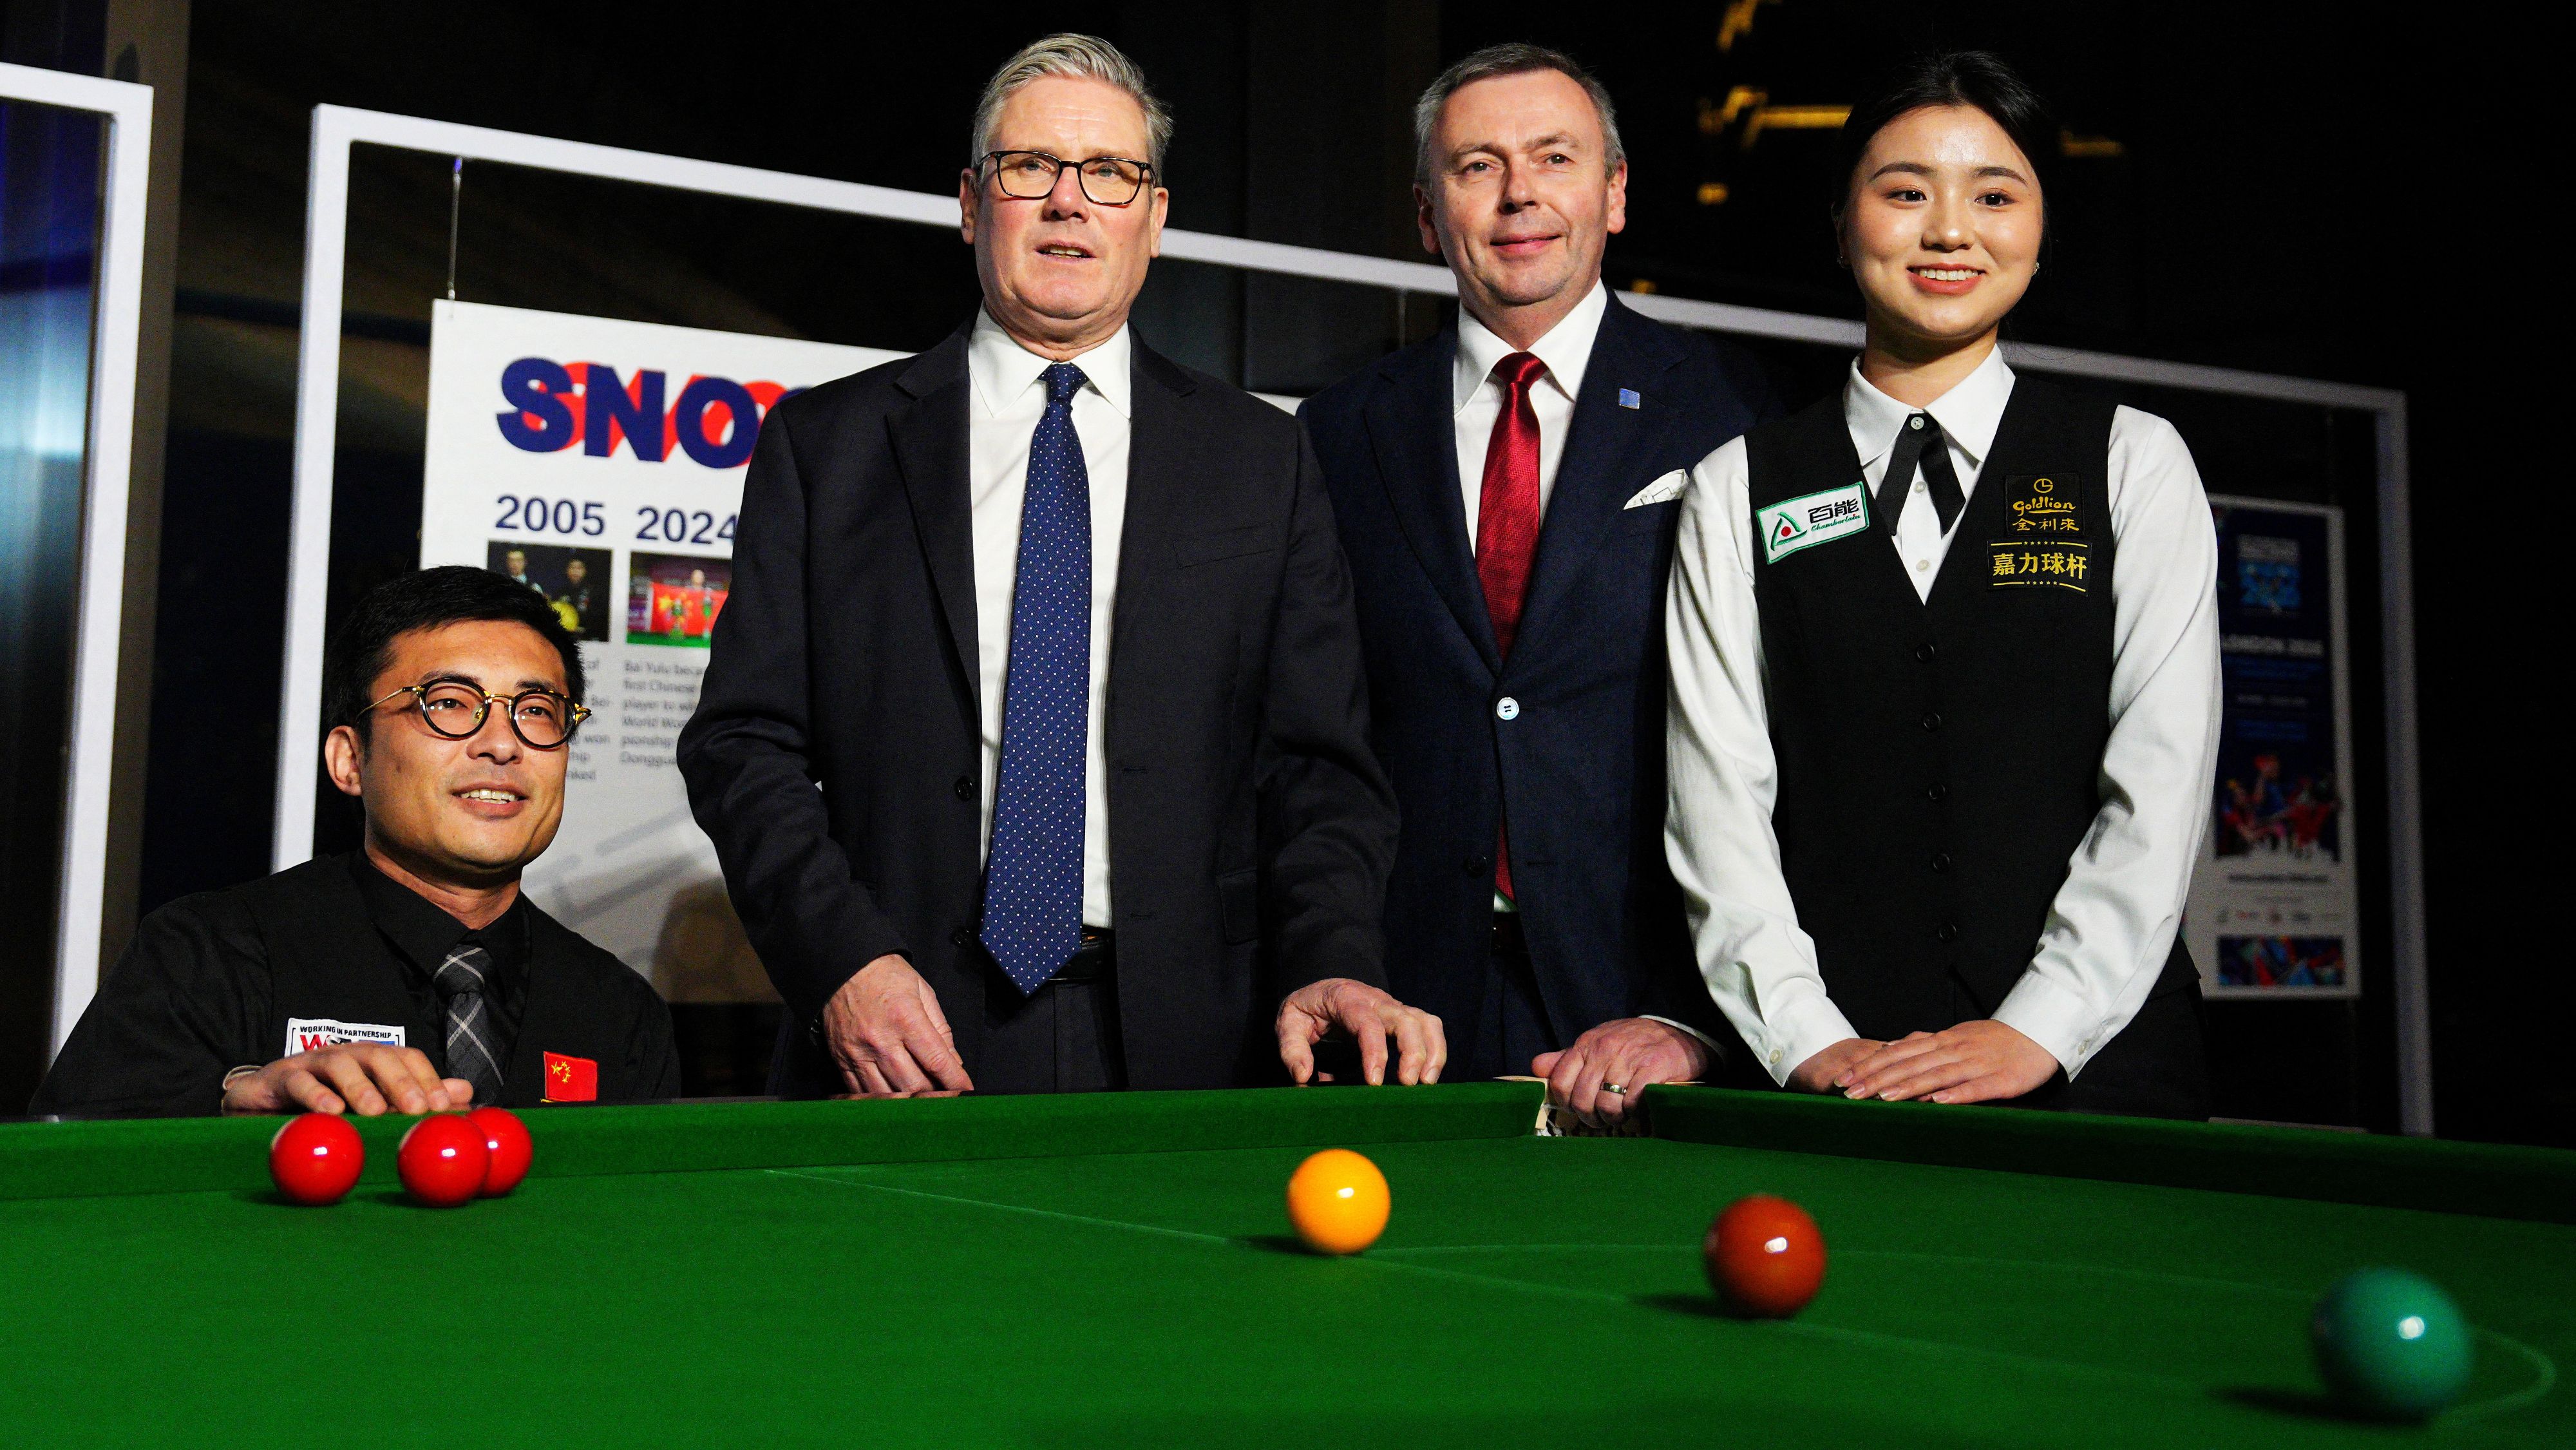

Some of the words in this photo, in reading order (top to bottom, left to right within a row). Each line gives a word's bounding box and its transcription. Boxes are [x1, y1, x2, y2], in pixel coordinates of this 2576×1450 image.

[496, 356, 814, 470] SNO
[495, 494, 605, 537] 2005
[1808, 498, 1859, 524] 百能
[635, 506, 738, 546] 2024
[1993, 552, 2087, 580] 嘉力球杆
[675, 664, 704, 676] beca
[619, 750, 677, 767] Donggua
[345, 1029, 392, 1038] PARTNERSHIP
